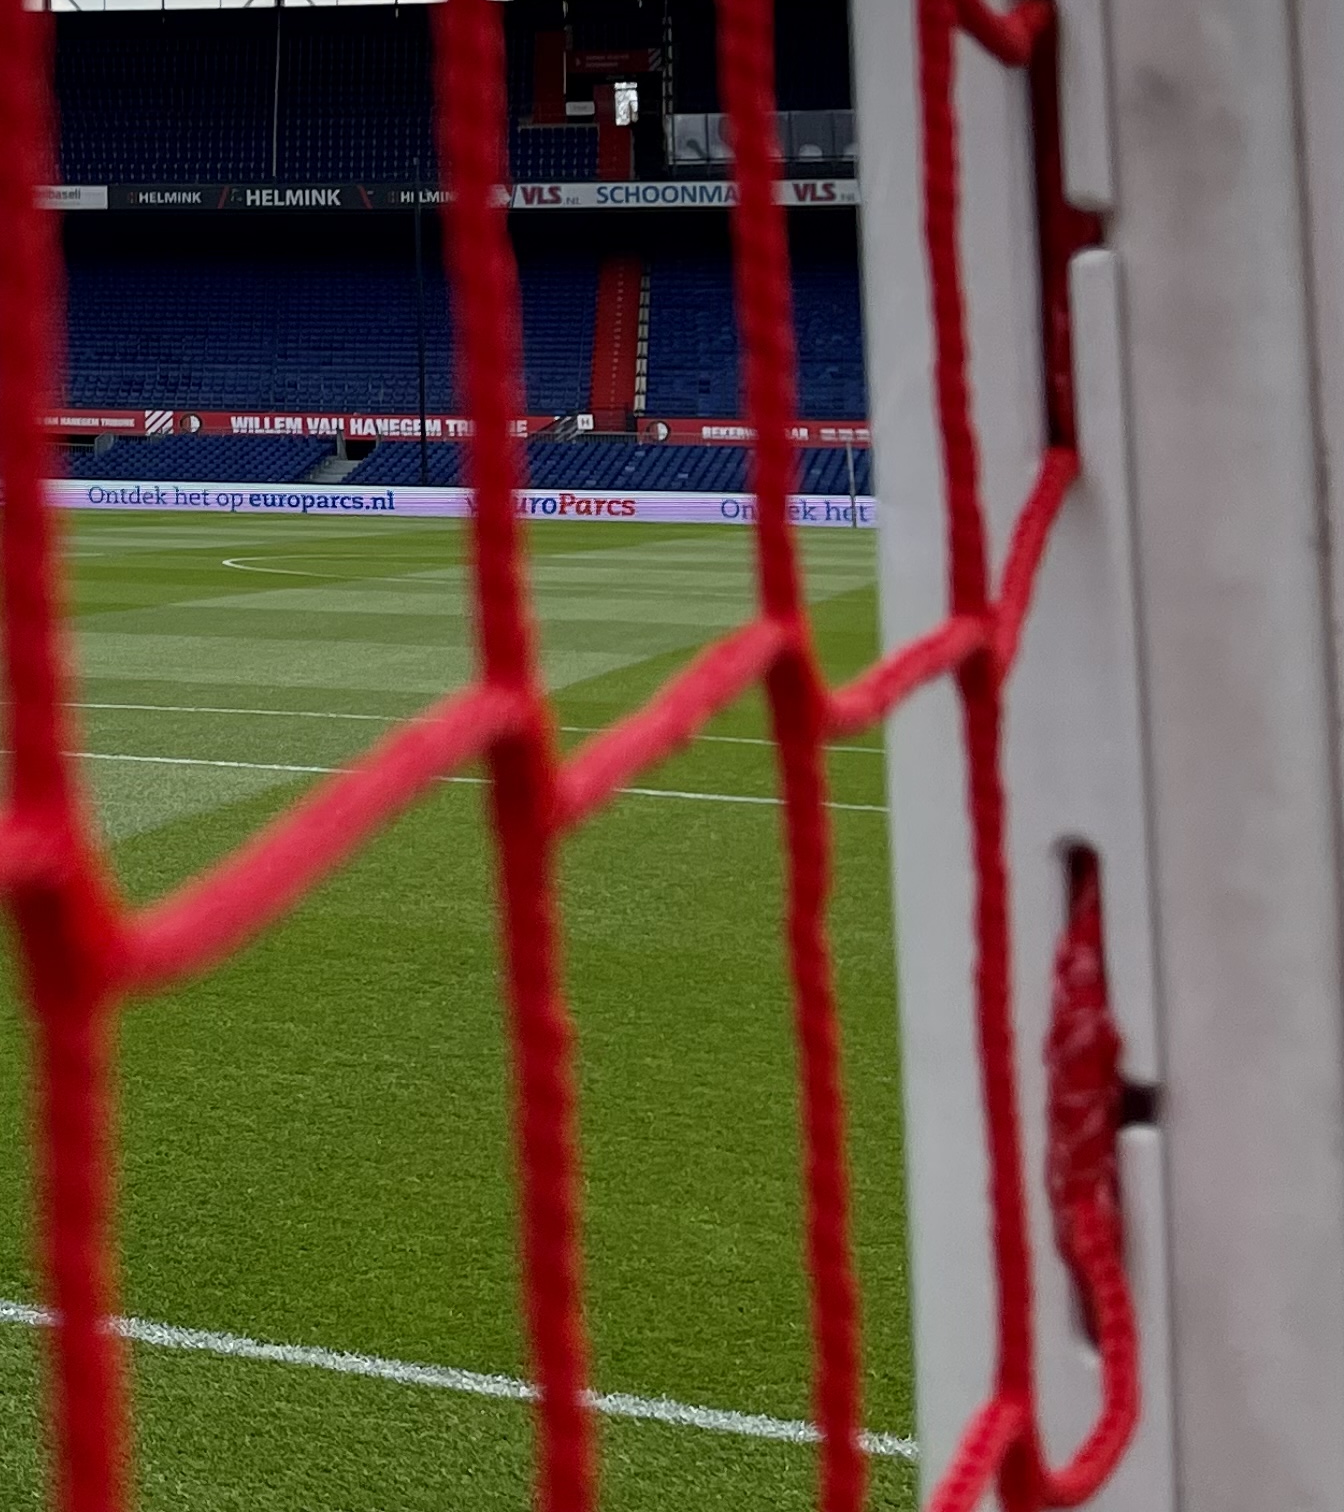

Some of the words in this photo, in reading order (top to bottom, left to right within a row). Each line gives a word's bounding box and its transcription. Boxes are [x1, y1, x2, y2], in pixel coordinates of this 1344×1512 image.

[137, 191, 202, 205] HELMINK
[245, 189, 342, 207] HELMINK
[230, 416, 303, 435] WILLEM
[306, 418, 345, 435] VAN
[349, 419, 442, 437] HANEGEM
[88, 485, 168, 506] Ontdek
[174, 486, 211, 507] het
[216, 493, 244, 513] op
[248, 490, 396, 515] europarcs.nl
[720, 499, 817, 522] Onek
